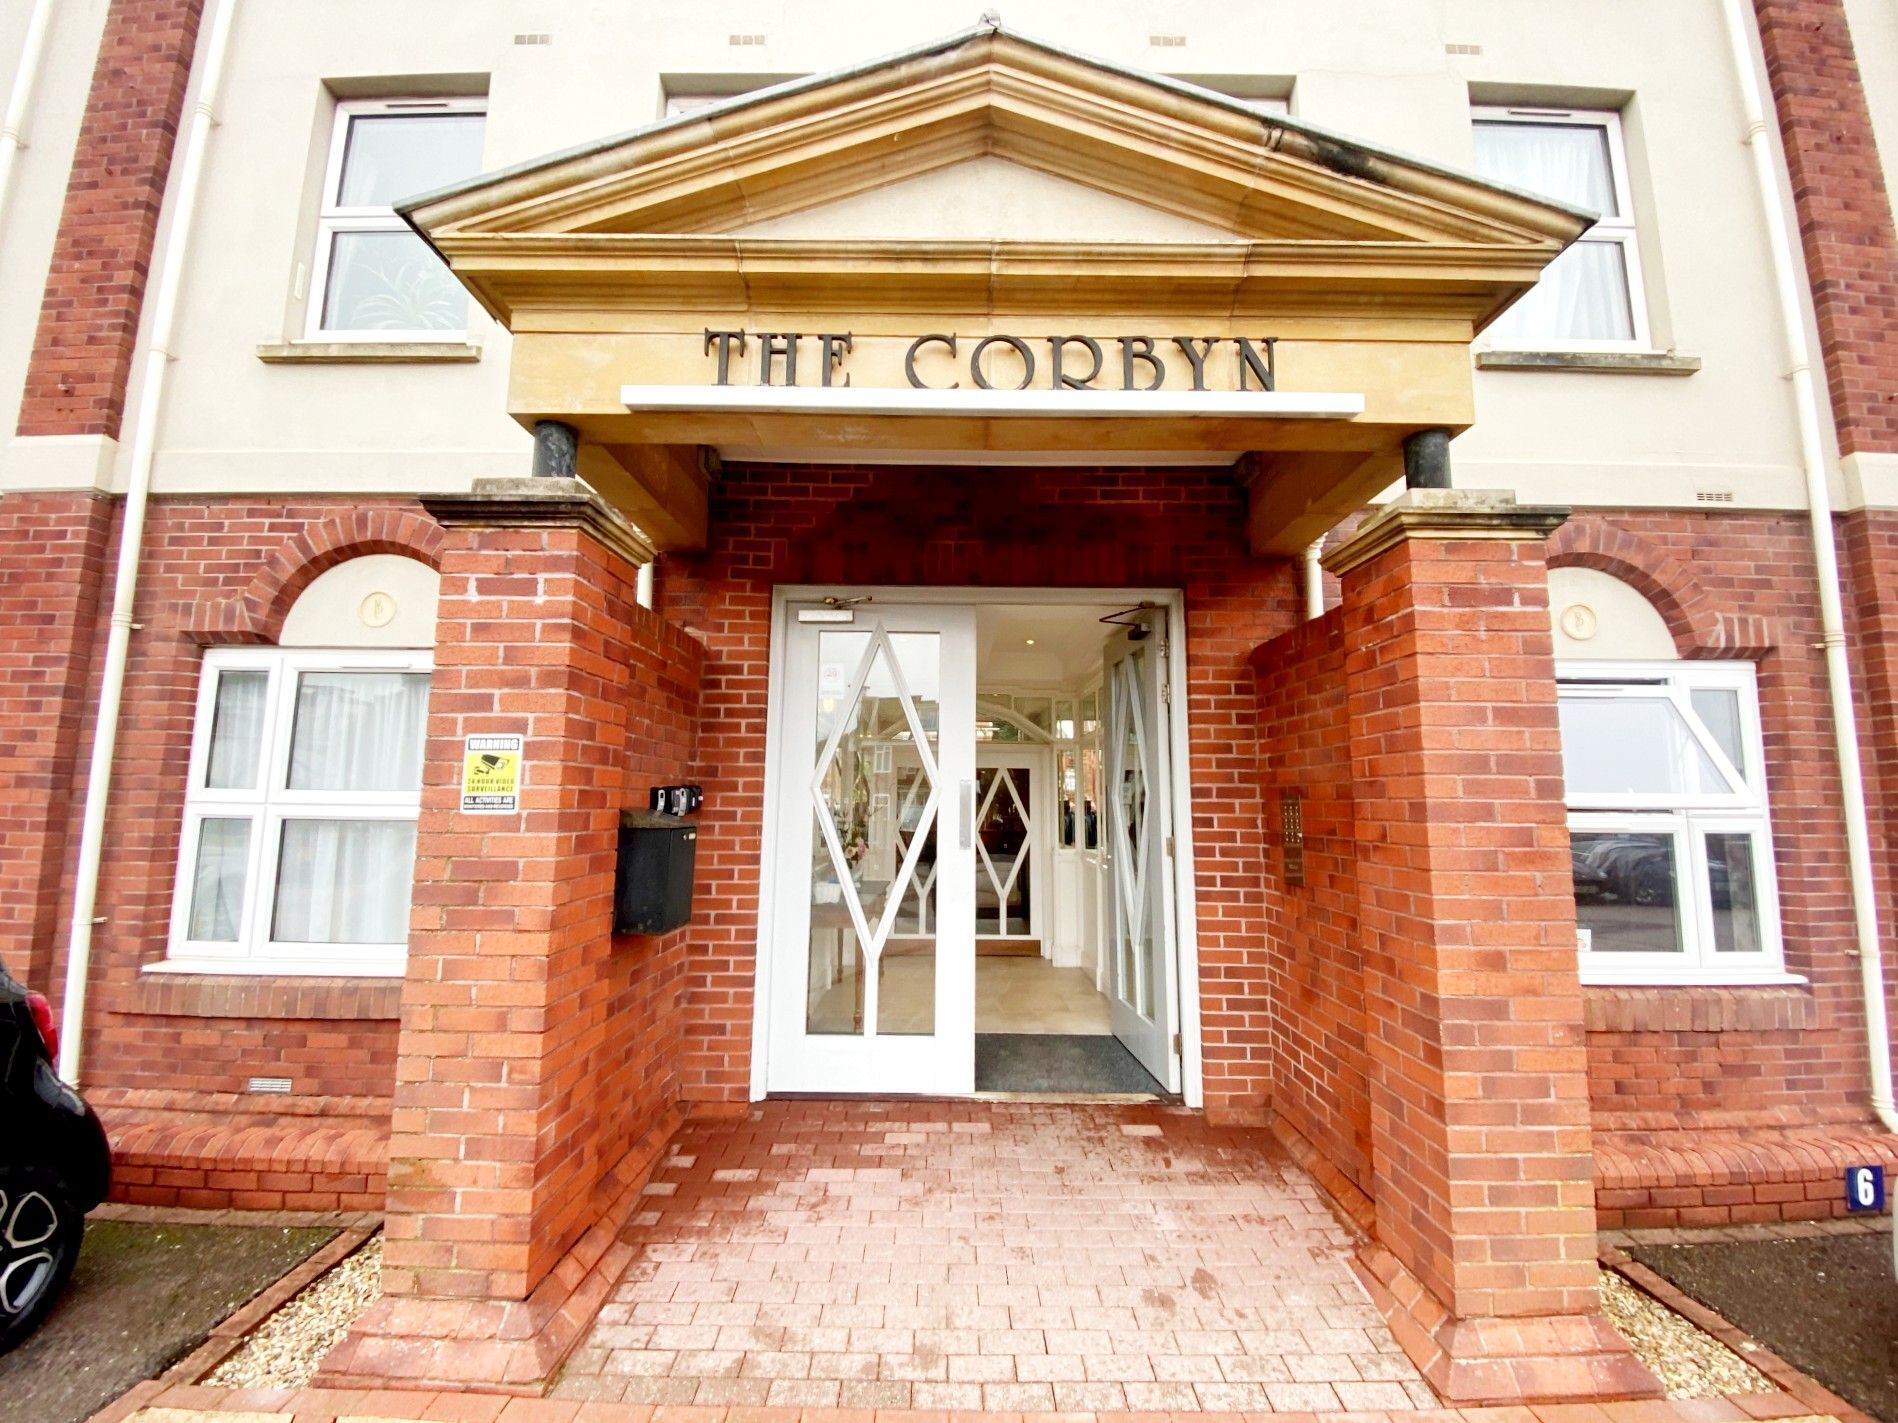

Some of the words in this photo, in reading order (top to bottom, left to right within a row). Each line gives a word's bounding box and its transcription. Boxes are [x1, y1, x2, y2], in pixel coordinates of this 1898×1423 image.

[704, 327, 853, 388] THE
[904, 331, 1279, 393] CORBYN
[469, 738, 518, 750] WARNING
[1857, 1167, 1875, 1206] 6
